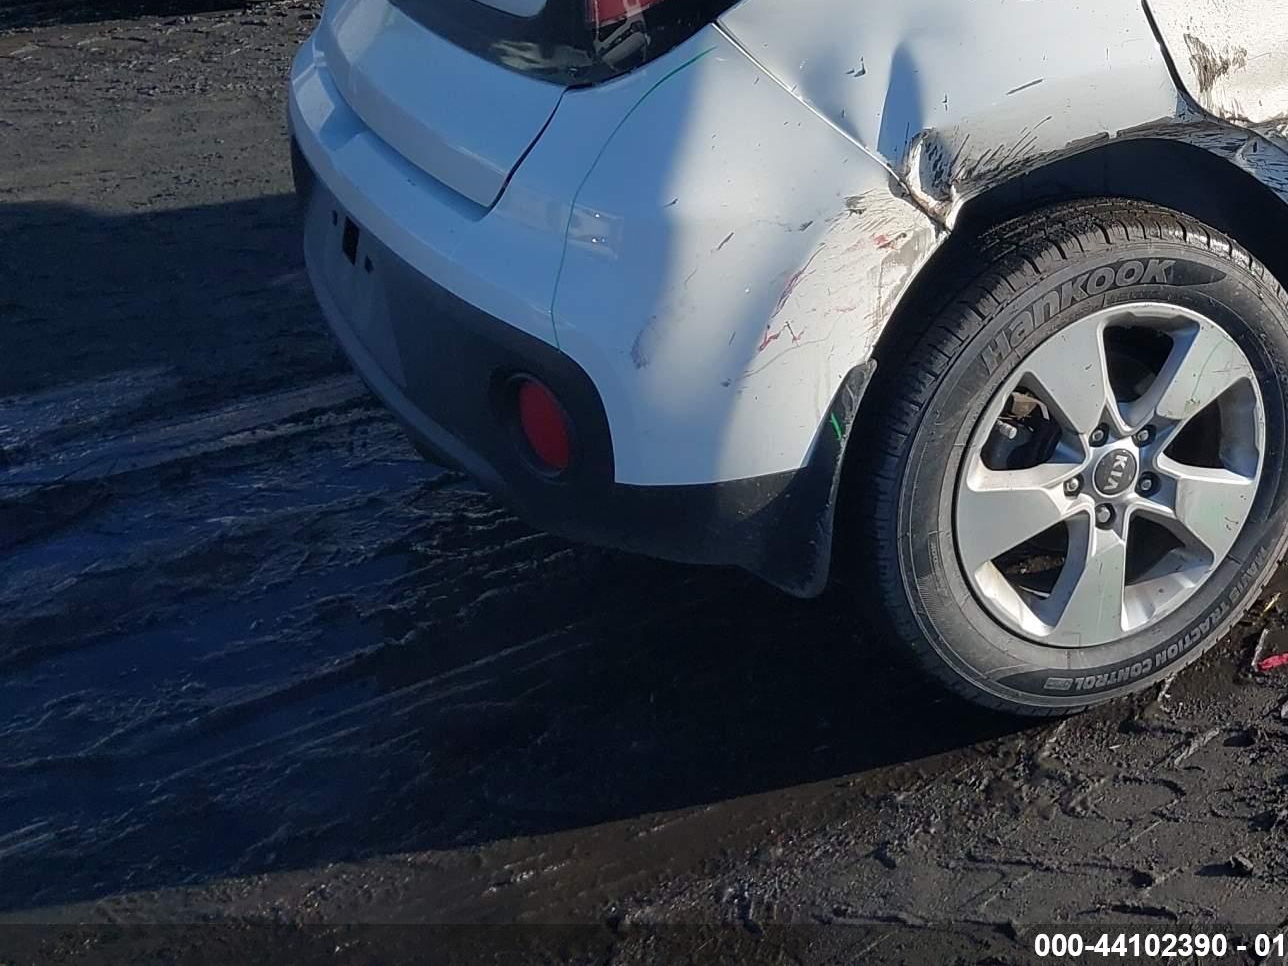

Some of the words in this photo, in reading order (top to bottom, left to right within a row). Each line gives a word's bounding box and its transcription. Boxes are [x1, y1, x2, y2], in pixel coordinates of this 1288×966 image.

[1103, 455, 1128, 490] KIA
[1155, 599, 1231, 669] TRACTION
[1075, 657, 1153, 691] CONTROL
